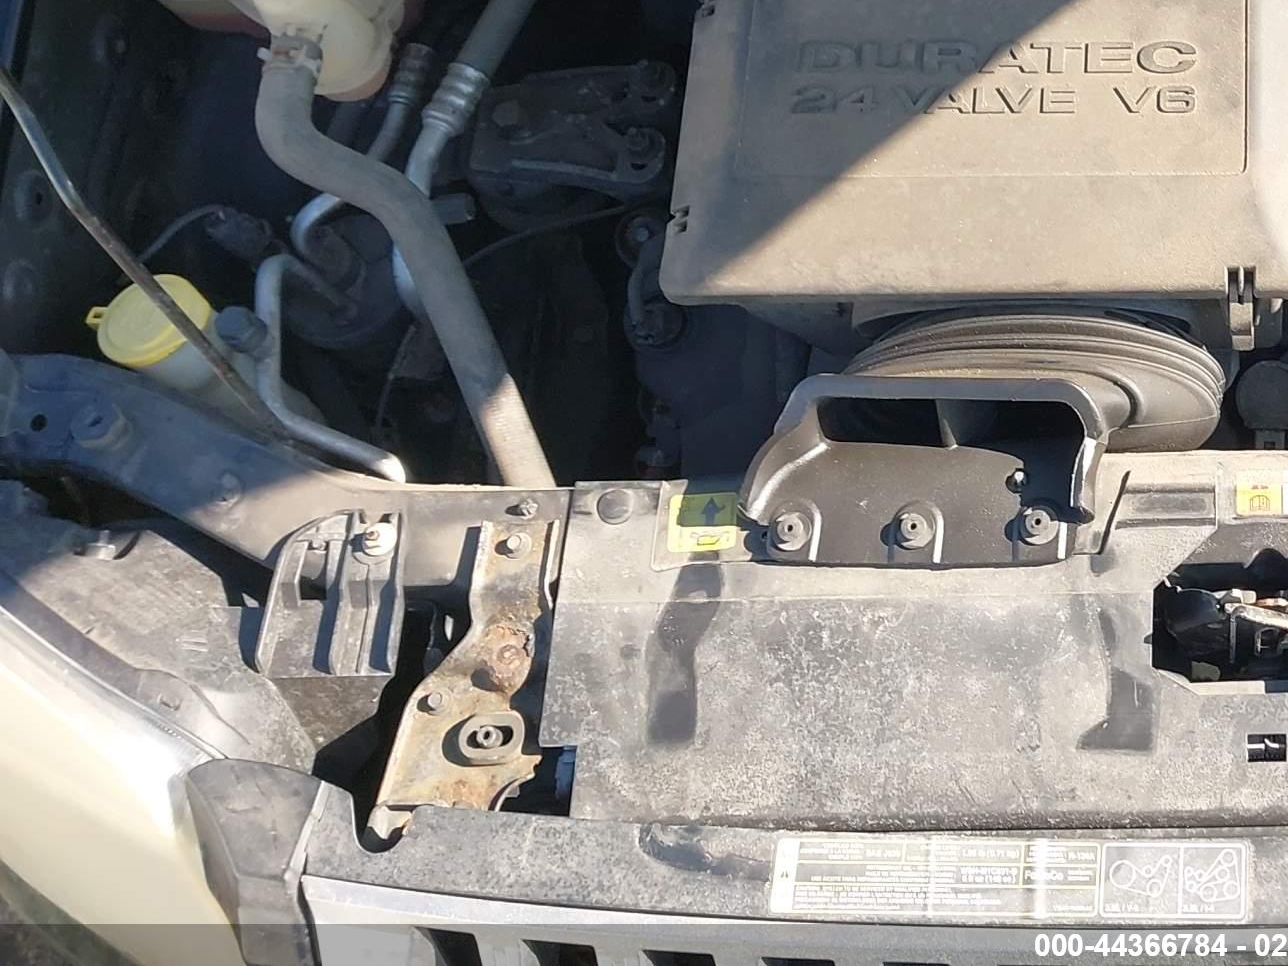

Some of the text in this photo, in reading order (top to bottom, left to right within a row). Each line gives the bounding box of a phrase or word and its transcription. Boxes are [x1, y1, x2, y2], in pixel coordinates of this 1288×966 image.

[798, 41, 1197, 73] DURATEC
[792, 85, 1197, 114] 24 VALVE V6
